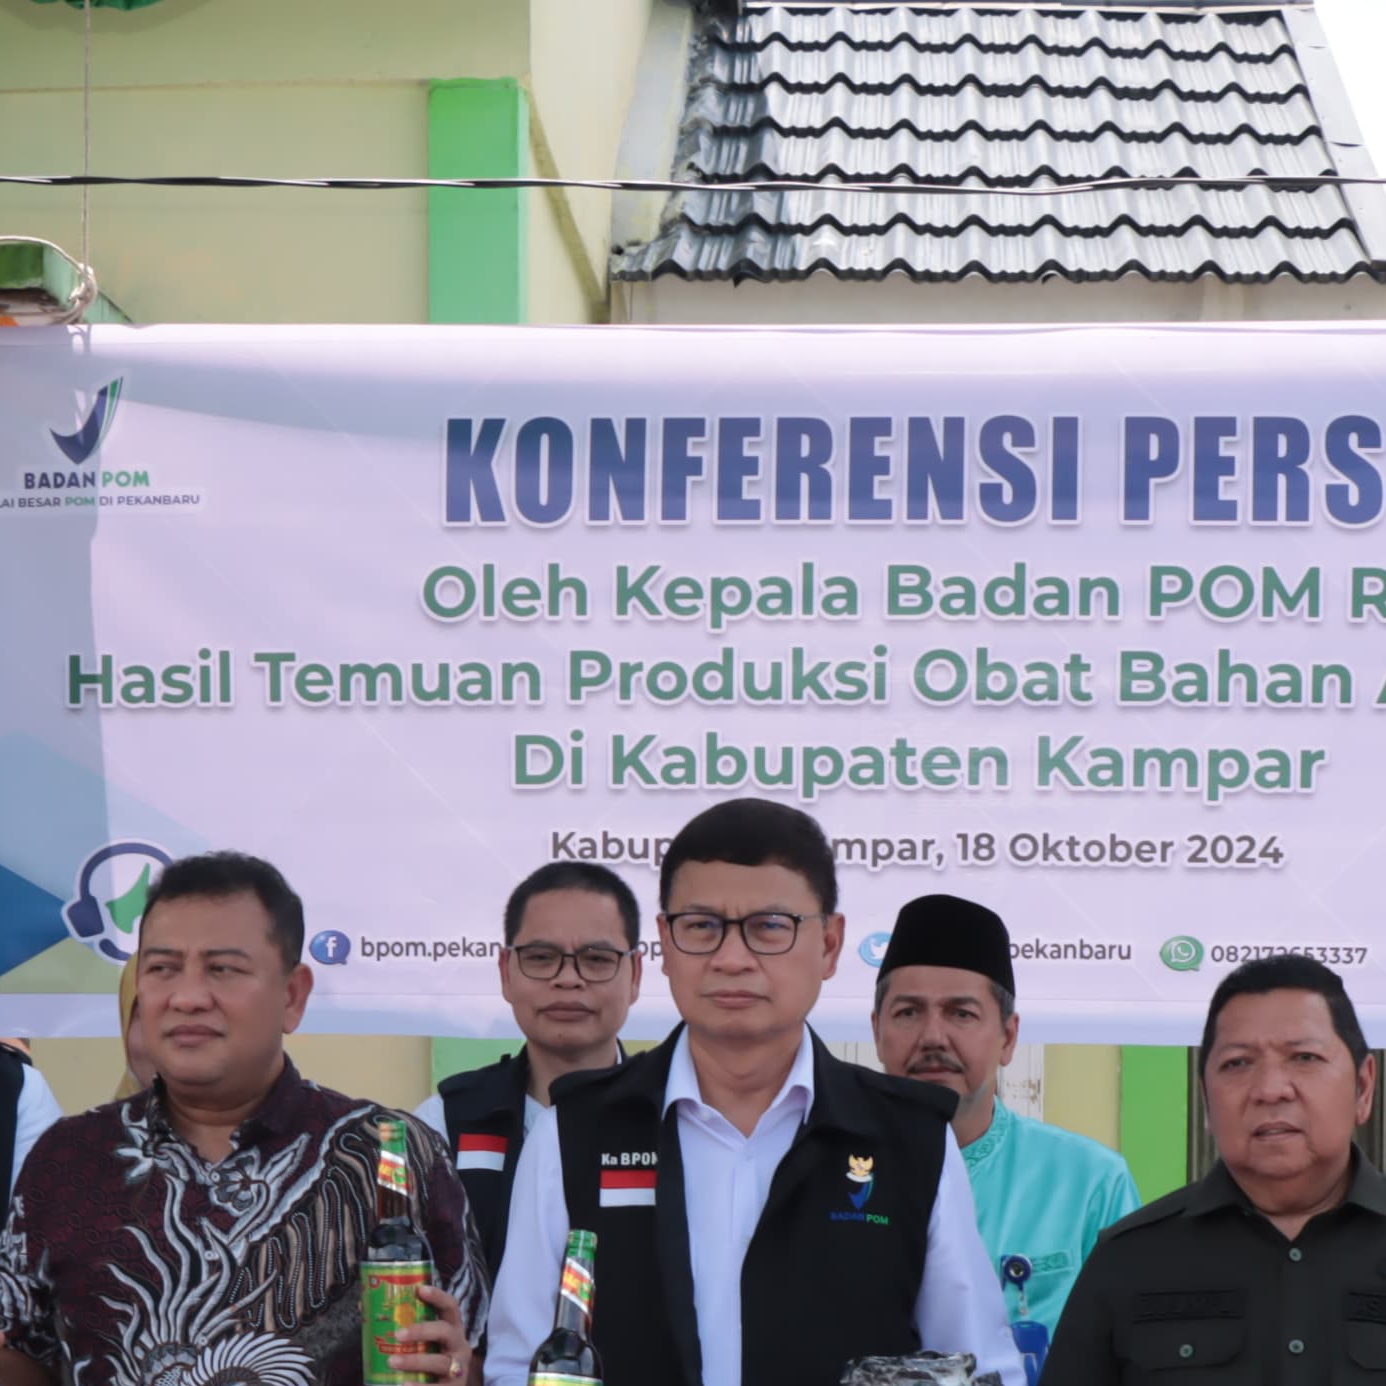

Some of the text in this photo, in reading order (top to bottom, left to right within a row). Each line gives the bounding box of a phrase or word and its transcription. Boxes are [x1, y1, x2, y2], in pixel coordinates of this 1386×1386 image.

[24, 470, 150, 490] BADAN POM
[446, 415, 1384, 525] KONFERENSI PERS
[18, 498, 61, 508] BESAR
[65, 497, 95, 506] POM
[99, 496, 113, 506] DI
[117, 495, 201, 506] PEKANBARU
[423, 564, 589, 620] Oleh
[614, 564, 858, 629] Kepala
[883, 562, 1121, 619] Badan
[1147, 565, 1322, 619] POM
[67, 650, 233, 706] Hasil
[254, 652, 543, 706] Temuan
[569, 646, 888, 704] Produksi
[913, 648, 1092, 706] Obat
[1117, 649, 1354, 706] Bahan
[514, 730, 1327, 801] Di Kabupaten Kampar
[551, 832, 1284, 867] Kabup mpar, 18 Oktober 2024
[601, 1152, 618, 1166] Ka
[866, 1213, 889, 1225] POM
